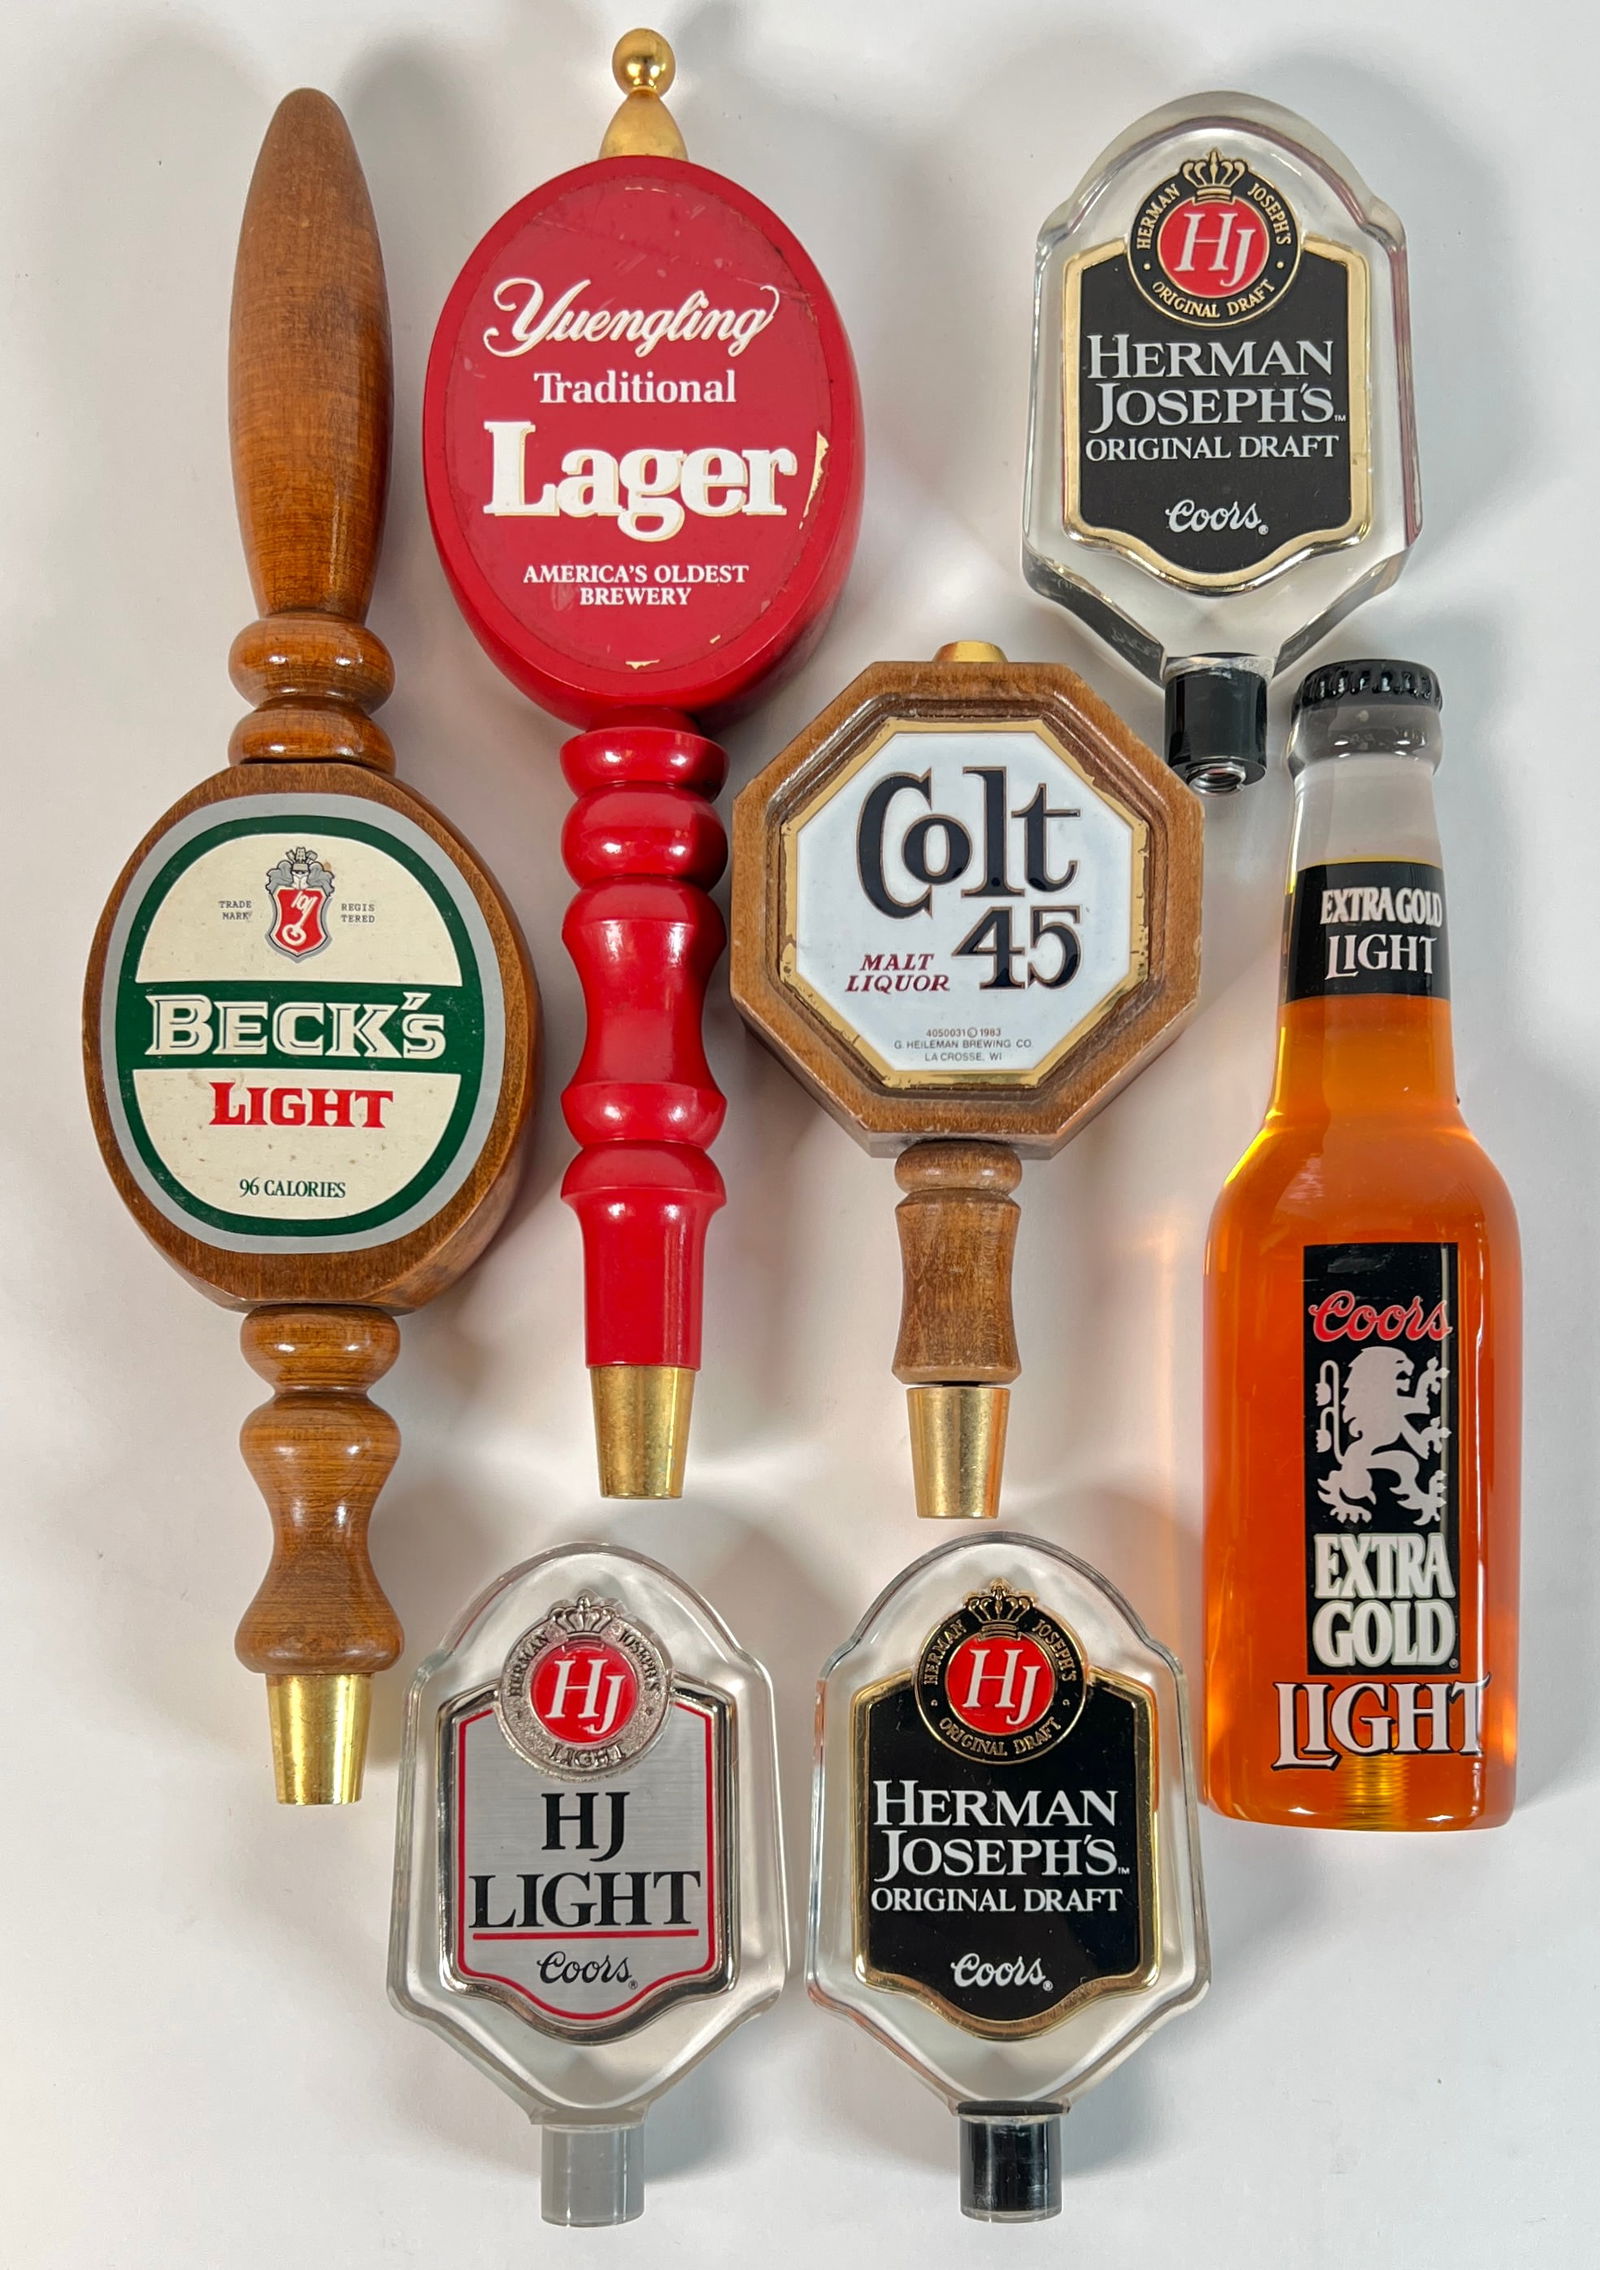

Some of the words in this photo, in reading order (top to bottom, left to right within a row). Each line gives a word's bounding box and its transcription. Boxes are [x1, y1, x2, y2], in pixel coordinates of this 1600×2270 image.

[1136, 183, 1180, 250] HERMAN
[1247, 182, 1291, 245] JOSEPH'S
[1173, 212, 1256, 288] HJ
[483, 276, 781, 358] Yuengling
[1152, 281, 1220, 318] ORIGINAL
[1227, 278, 1275, 317] DRAFT
[1086, 333, 1335, 380] HERMAN
[534, 370, 737, 404] Traditional
[1085, 437, 1232, 462] ORIGINAL
[1239, 435, 1340, 460] DRAFT
[483, 420, 798, 542] Lager
[523, 564, 647, 584] AMERICA'S
[654, 564, 750, 584] OLDEST
[579, 587, 692, 605] BREWERY
[856, 766, 1081, 919] Colt
[218, 900, 252, 909] TRADE
[341, 903, 375, 912] REGIS
[341, 914, 376, 923] TERED
[1320, 886, 1397, 925] EXTRA
[1395, 887, 1443, 928] GOLD
[859, 953, 935, 972] MALT
[950, 905, 1083, 991] 45
[1324, 933, 1438, 981] LIGHT
[845, 974, 951, 995] LIQUOR
[144, 991, 447, 1060] BECK'S
[906, 1039, 959, 1049] HEILEMAN
[962, 1038, 1012, 1048] BREWING
[924, 1051, 938, 1062] LA
[989, 1051, 1003, 1061] WI
[208, 1081, 394, 1128] LIGHT
[239, 1178, 259, 1197] 96
[264, 1180, 347, 1198] CALORIES
[1308, 1290, 1453, 1343] Coors
[1313, 1532, 1456, 1600] EXTRA
[923, 1619, 967, 1686] HERMAN
[544, 1659, 627, 1735] HJ
[961, 1648, 1041, 1725] HJ
[939, 1717, 1008, 1756] ORIGINAL
[1012, 1716, 1062, 1754] DRAFT
[1271, 1672, 1491, 1772] LIGHT
[540, 1791, 631, 1862] HJ
[873, 1780, 1116, 1828] HERMAN
[468, 1871, 701, 1929] LIGHT
[871, 1889, 1016, 1912] ORIGINAL
[1024, 1888, 1123, 1912] DRAFT
